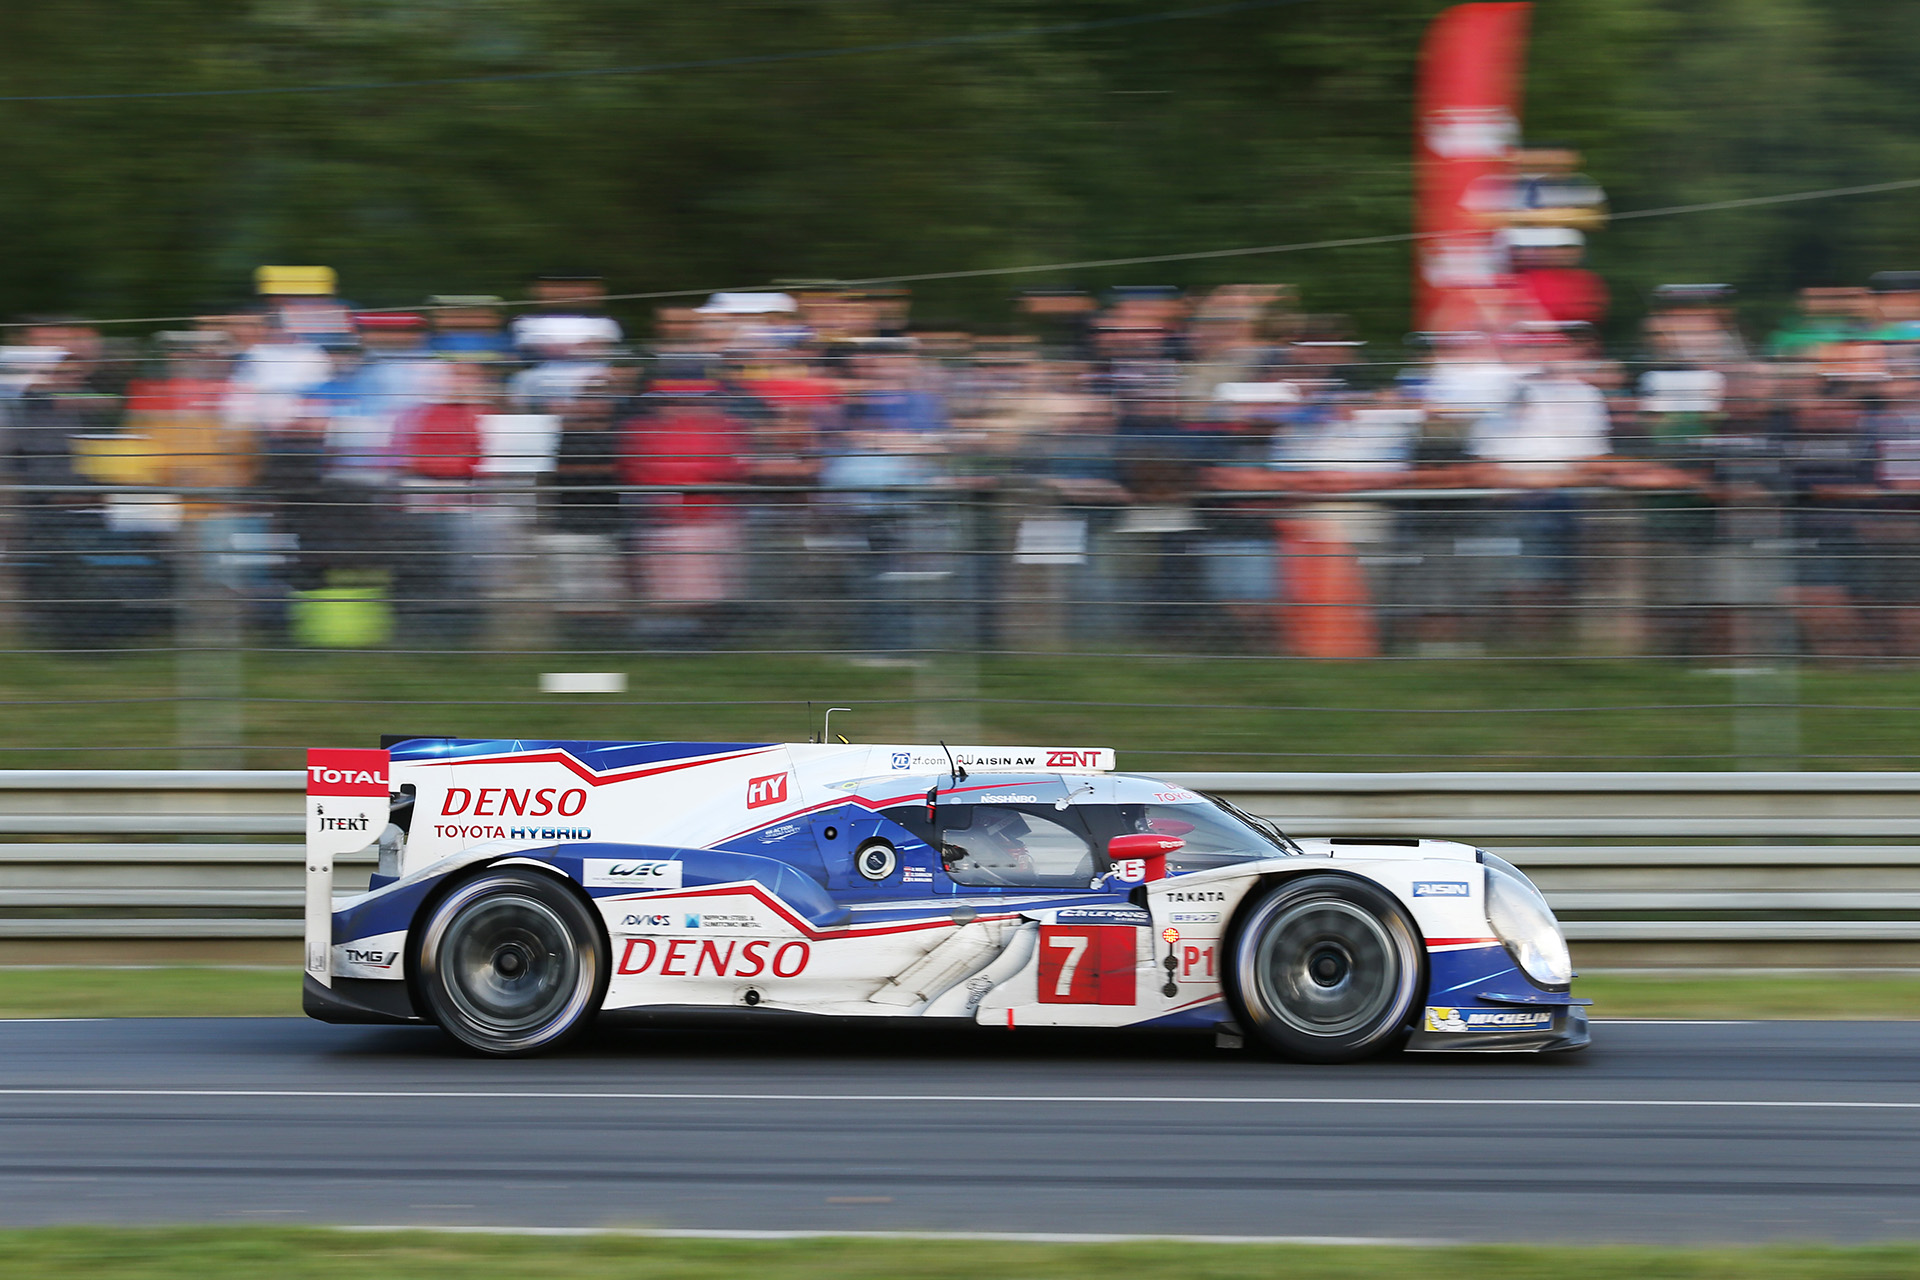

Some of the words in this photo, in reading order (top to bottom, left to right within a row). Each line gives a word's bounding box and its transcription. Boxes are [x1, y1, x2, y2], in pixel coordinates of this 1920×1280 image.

[894, 754, 909, 768] ZF
[913, 756, 946, 765] zf.com
[976, 757, 1011, 766] AISIN
[1016, 757, 1036, 765] AW
[1046, 751, 1101, 767] ZENT
[307, 766, 389, 784] TOTAL
[749, 775, 787, 804] HY
[440, 788, 587, 817] DENSO
[318, 818, 369, 832] JTEKT
[434, 825, 506, 839] TOYOTA
[510, 826, 592, 840] HYBRID
[609, 863, 669, 876] WEC
[1415, 884, 1468, 895] AISIN
[1166, 892, 1226, 902] TAKATA
[346, 949, 383, 963] TMG
[616, 938, 810, 978] DENSO
[1183, 945, 1214, 976] P1
[1049, 936, 1088, 996] 7
[1466, 1012, 1552, 1025] MICHELIN
